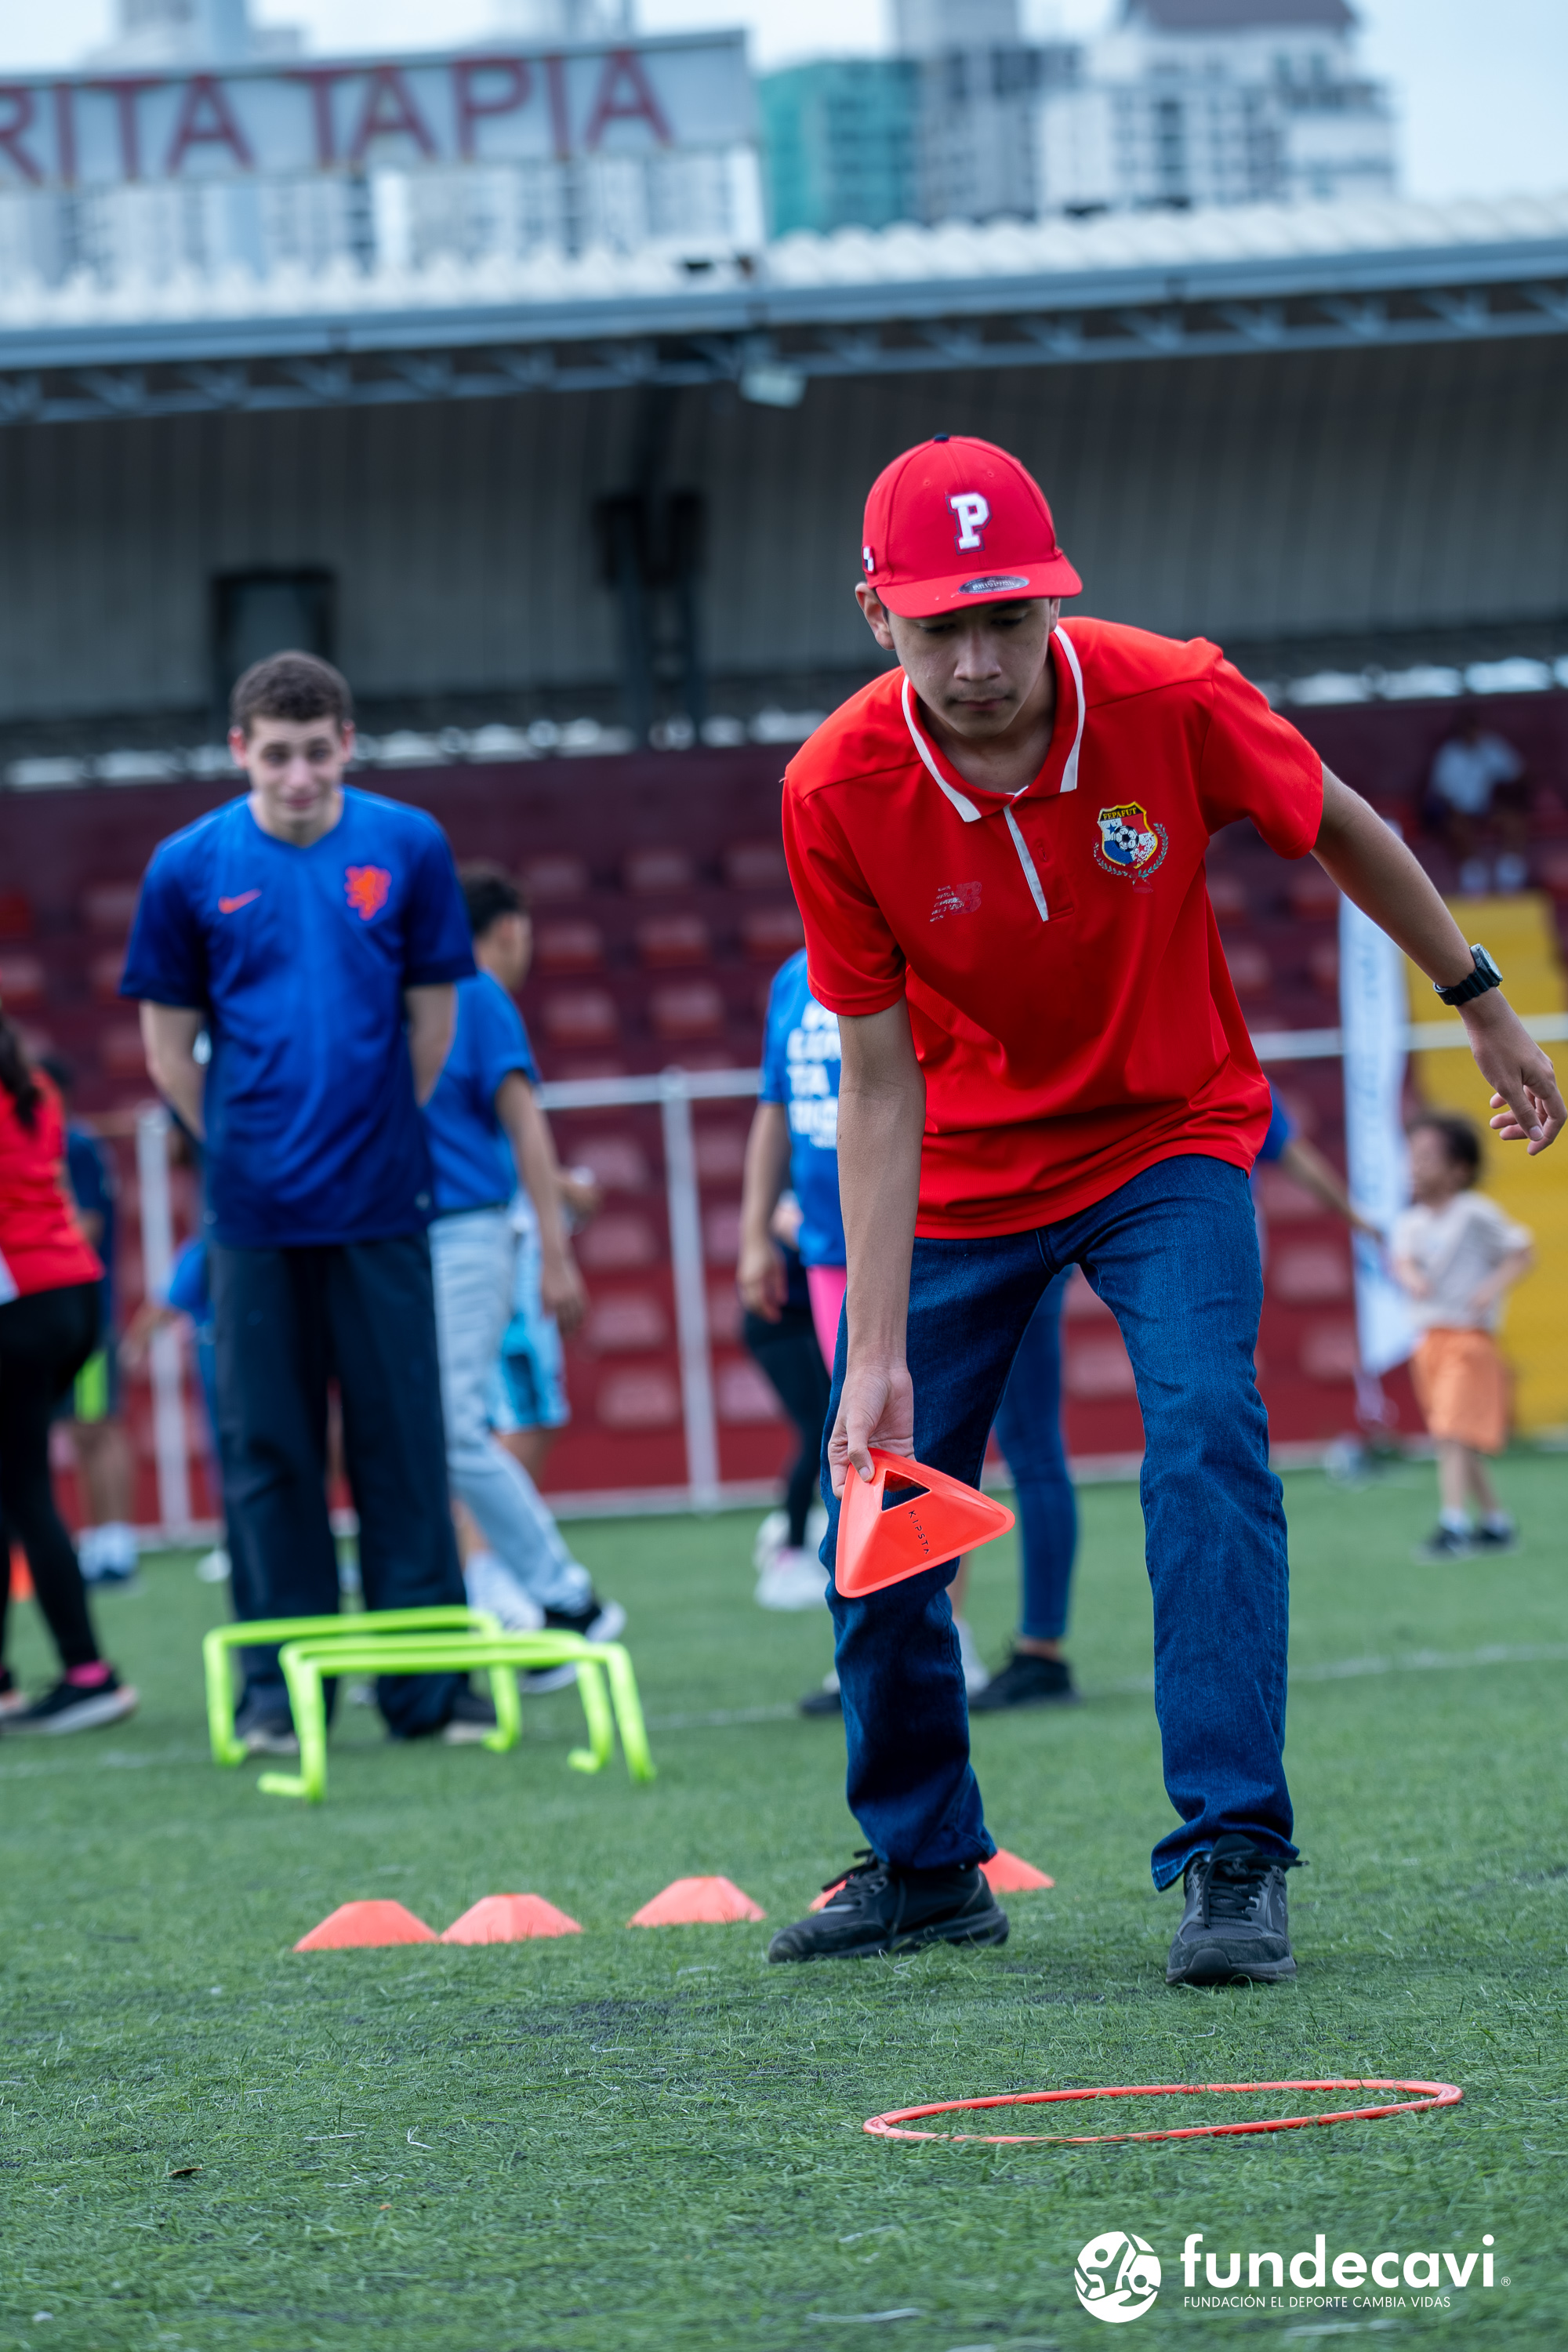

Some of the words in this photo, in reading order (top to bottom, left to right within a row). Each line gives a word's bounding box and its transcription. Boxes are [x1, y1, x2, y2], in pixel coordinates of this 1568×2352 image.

[279, 49, 676, 168] TAPIA
[948, 492, 990, 552] P
[1102, 807, 1137, 820] FEPAFUT
[908, 1510, 930, 1555] KIPSTA
